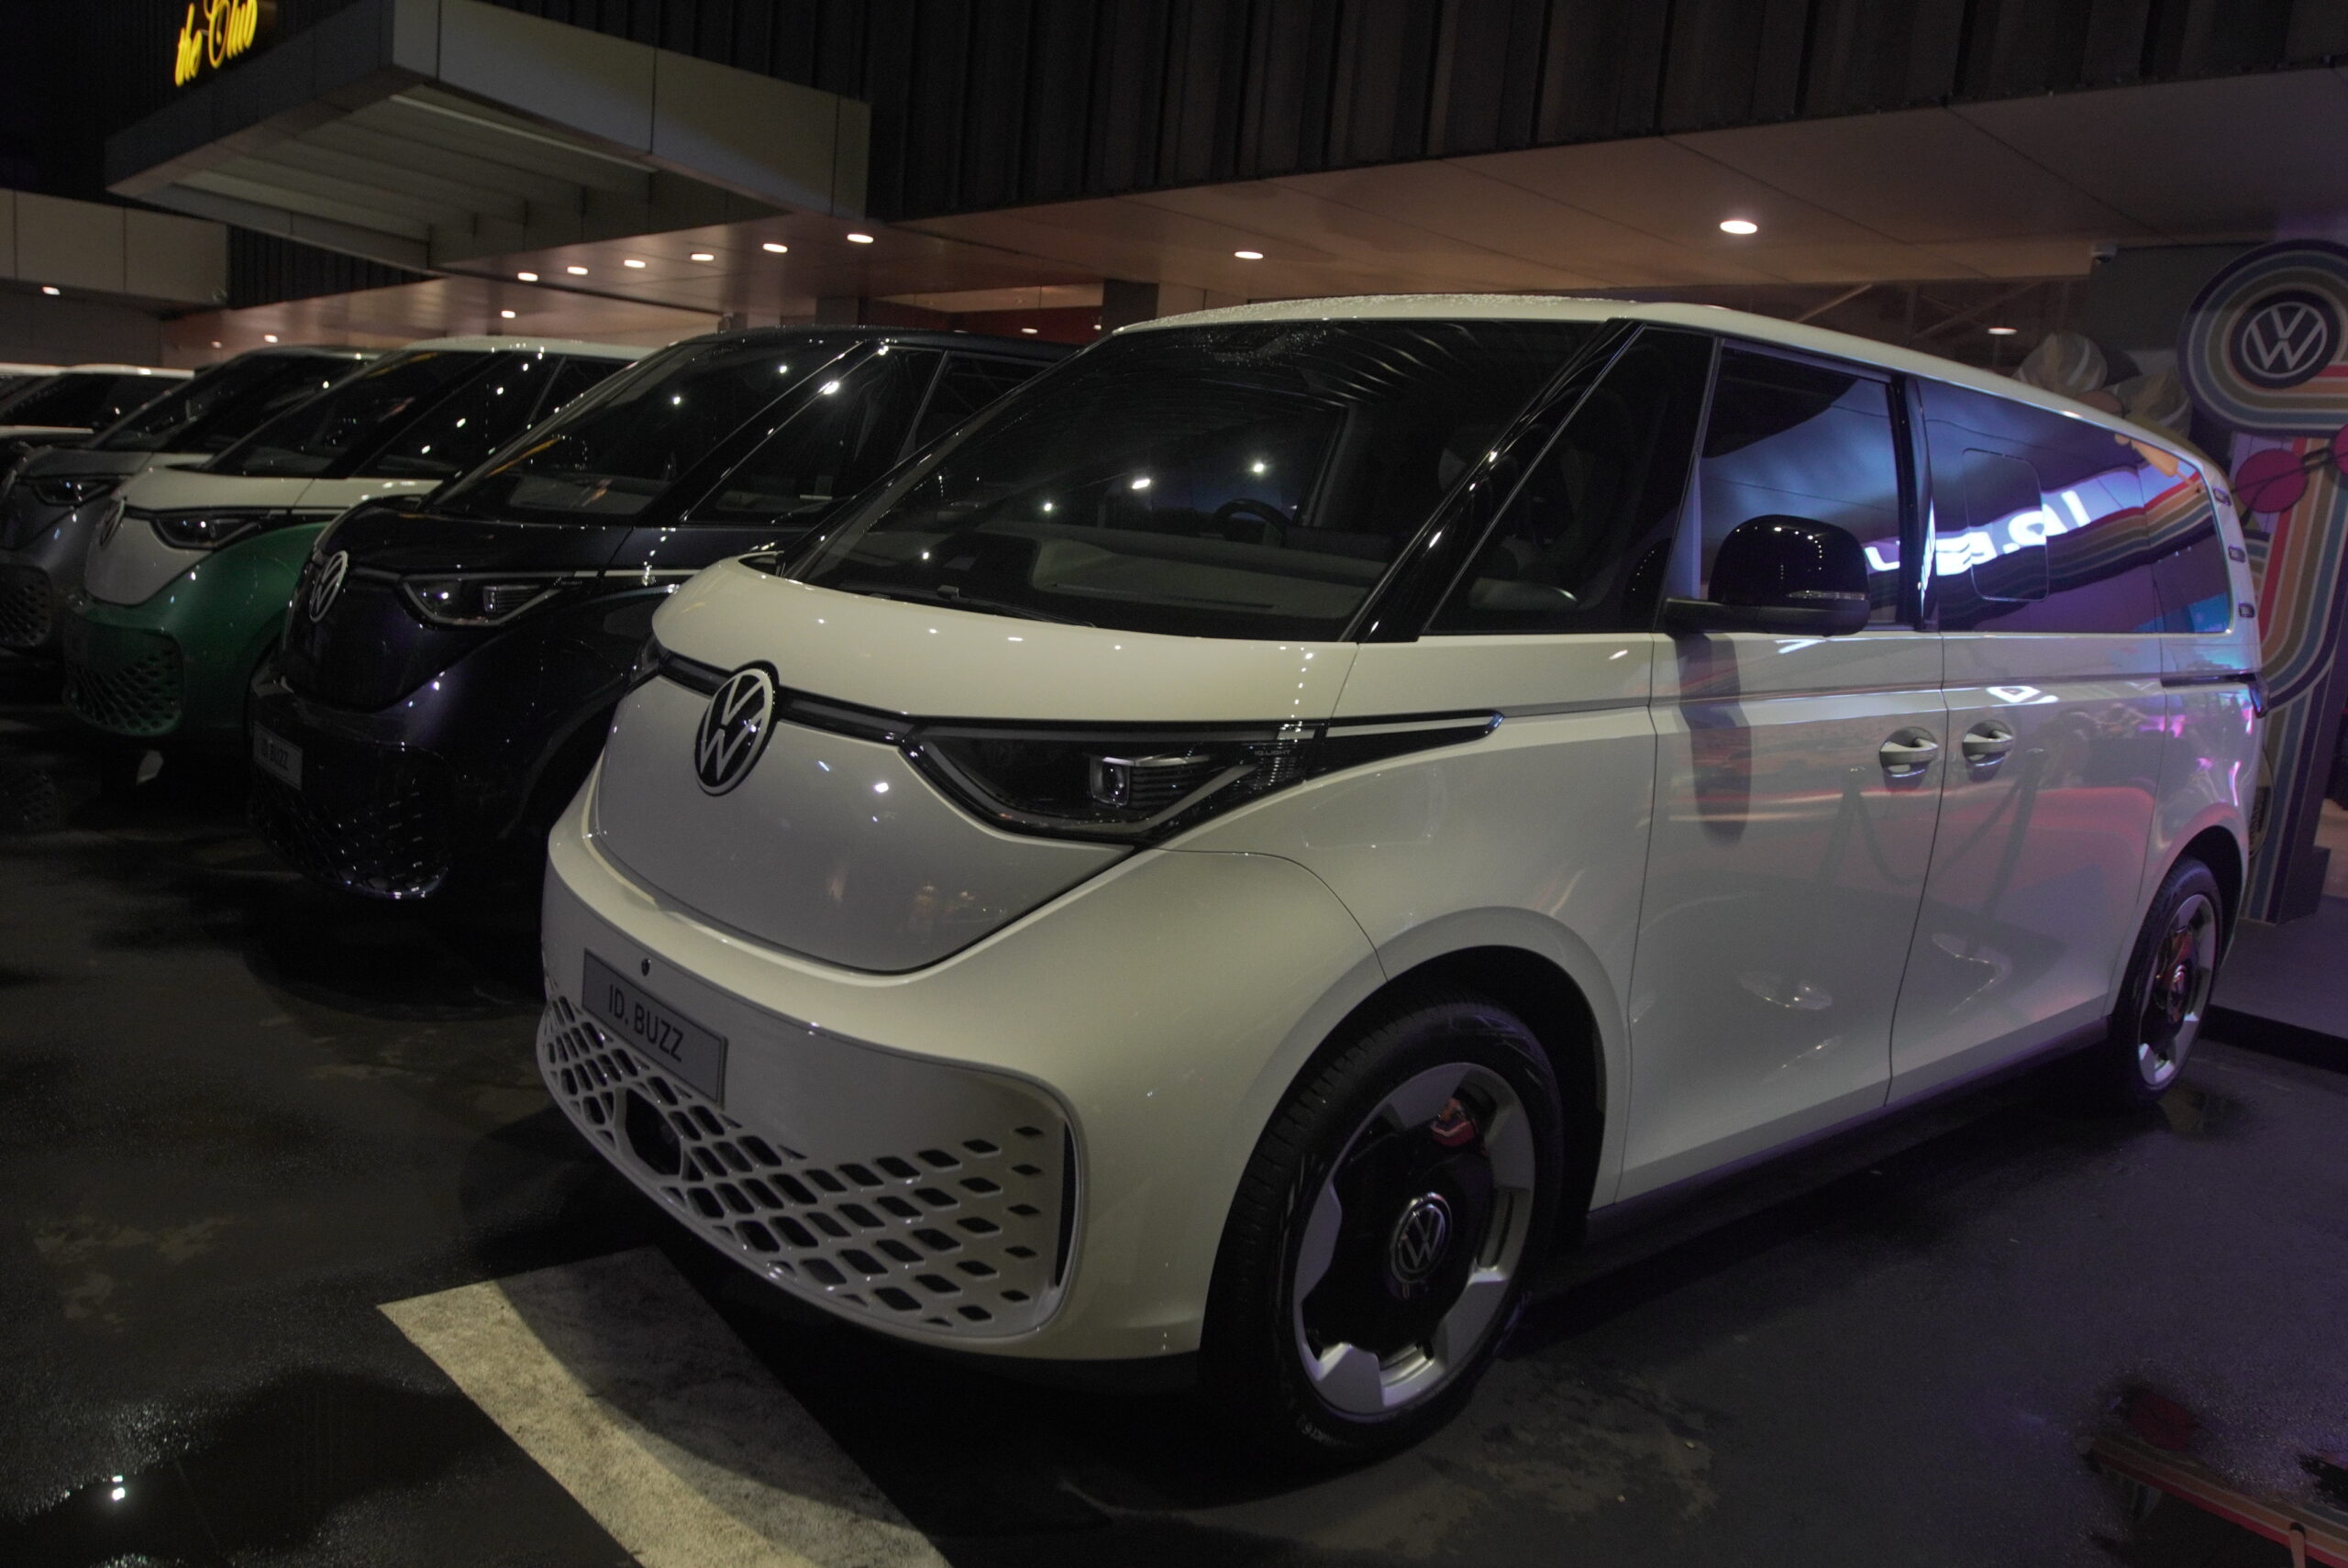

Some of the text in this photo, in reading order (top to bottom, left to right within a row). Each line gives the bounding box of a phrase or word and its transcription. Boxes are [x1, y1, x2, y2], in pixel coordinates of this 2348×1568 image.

[175, 3, 203, 87] the
[2242, 302, 2328, 379] VW
[698, 668, 773, 795] VW
[609, 984, 683, 1063] ID. BUZZ
[1398, 1203, 1446, 1275] VW
